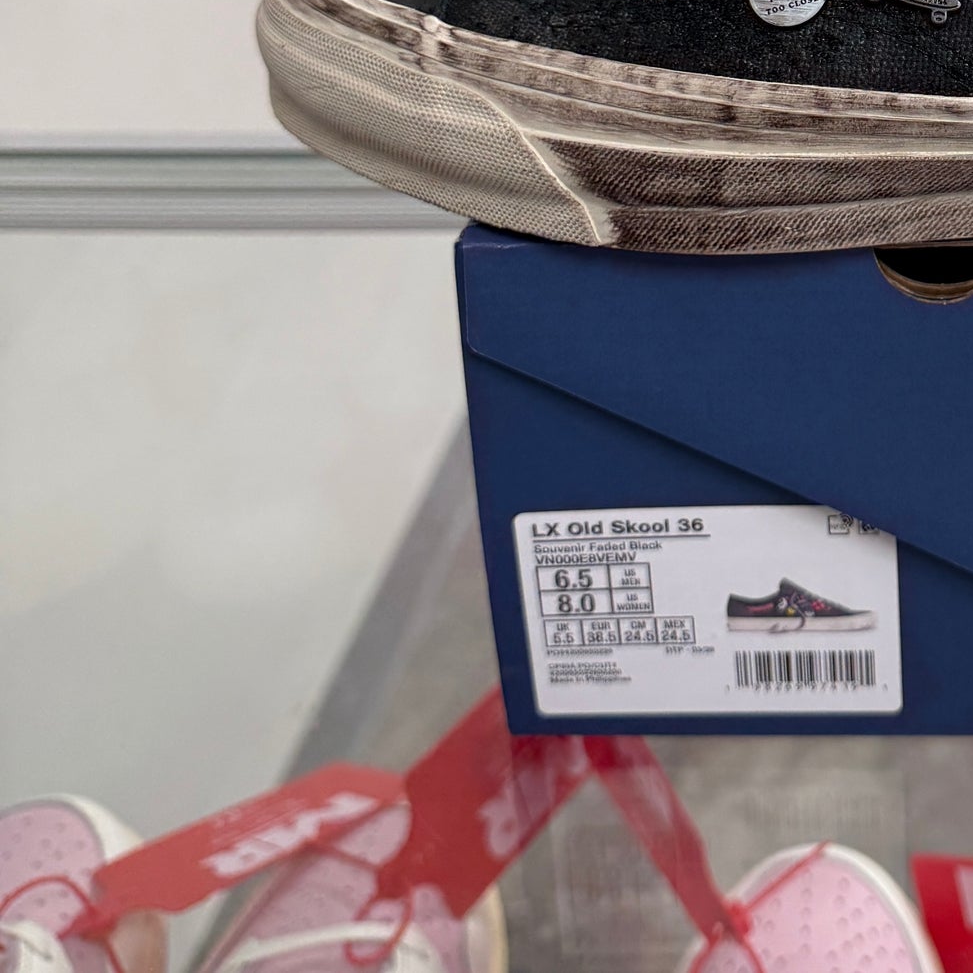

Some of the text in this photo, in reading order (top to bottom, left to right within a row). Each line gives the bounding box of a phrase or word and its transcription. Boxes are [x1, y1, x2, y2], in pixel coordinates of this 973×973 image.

[765, 4, 785, 15] TOO
[532, 518, 704, 537] LX Old Skool 36
[534, 540, 662, 554] Souvenir Faded Black
[555, 568, 593, 588] 6.5
[624, 568, 636, 577] US
[621, 577, 640, 585] MEN
[627, 593, 638, 601] US
[558, 593, 595, 613] 8.0
[616, 602, 650, 611] WOMEN
[556, 622, 570, 631] UK
[591, 620, 611, 630] EUR
[630, 619, 646, 629] CM
[664, 619, 685, 629] MEX
[553, 632, 575, 644] 5.5
[587, 631, 617, 643] 38.5
[624, 630, 655, 642] 24.5
[661, 629, 691, 642] 24.5
